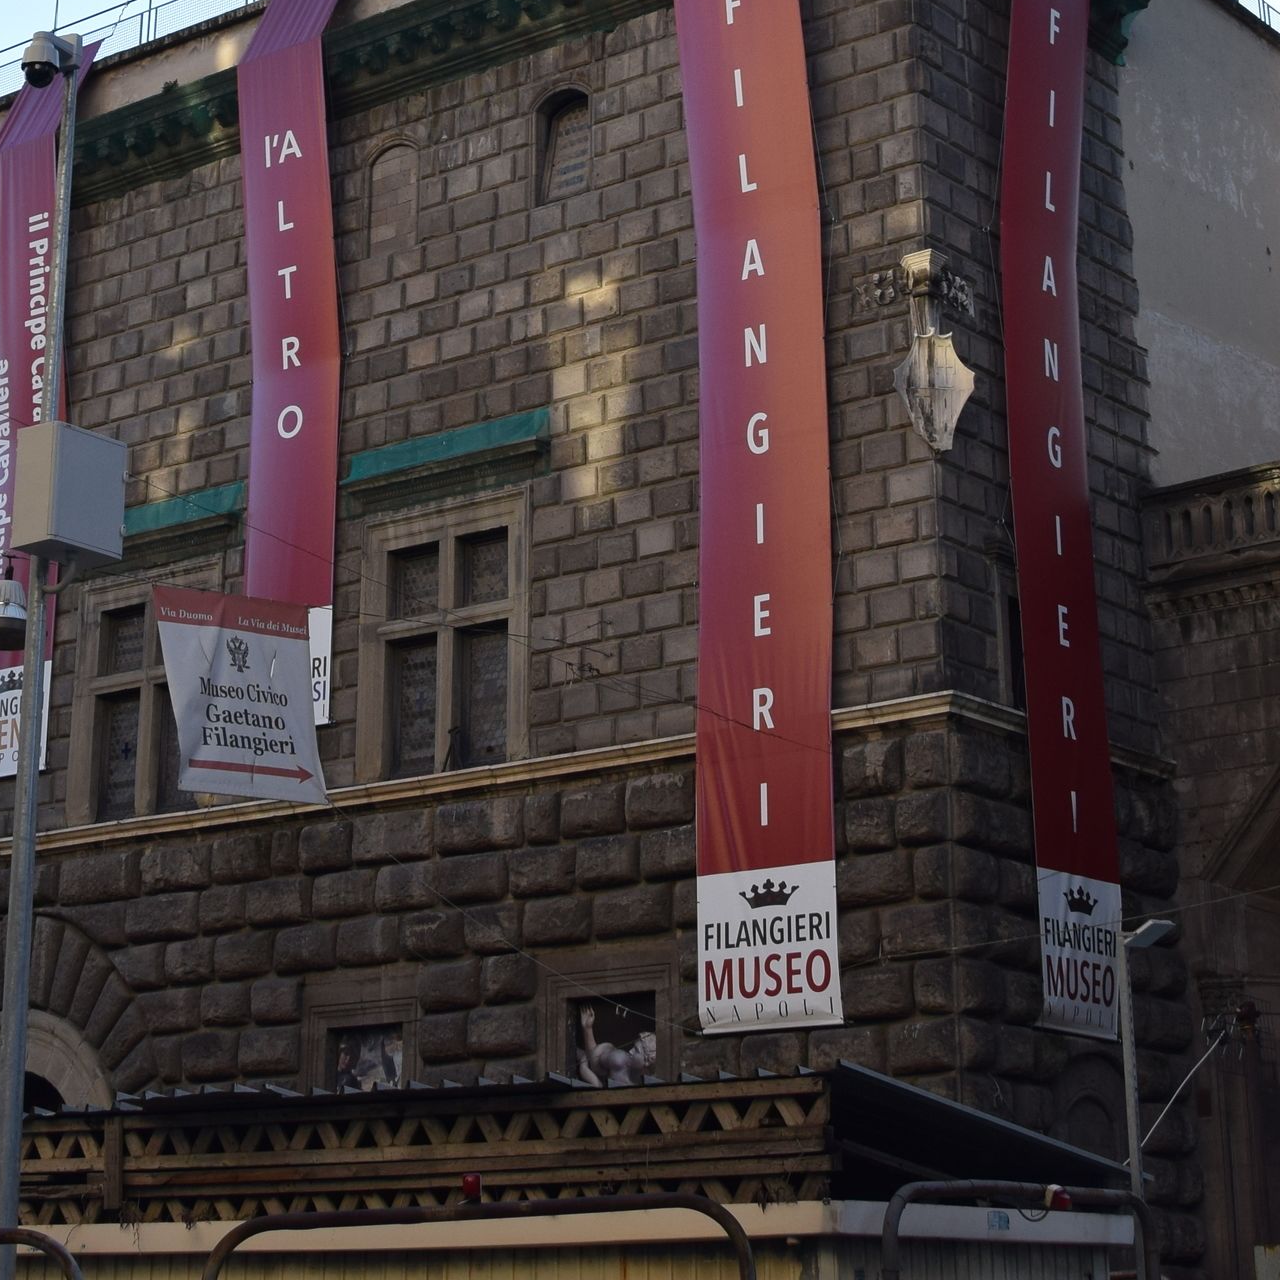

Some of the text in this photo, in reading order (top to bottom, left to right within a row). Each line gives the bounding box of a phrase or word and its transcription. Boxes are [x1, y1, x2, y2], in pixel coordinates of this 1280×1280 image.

[28, 212, 50, 233] il
[25, 237, 50, 350] Principe
[1041, 7, 1077, 833] FILANGIERI
[160, 606, 213, 621] Via Duomo
[238, 616, 307, 635] La Via dei Musei
[199, 676, 244, 701] Museo
[246, 683, 288, 707] Civico
[206, 703, 286, 730] Gaetano
[201, 726, 297, 756] Filangieri
[704, 911, 831, 951] FILANGIERI
[1043, 917, 1117, 958] FILANGIERI
[704, 948, 832, 1002] MUSEO
[1046, 954, 1115, 1008] MUSEO
[706, 996, 834, 1024] NAPOLI
